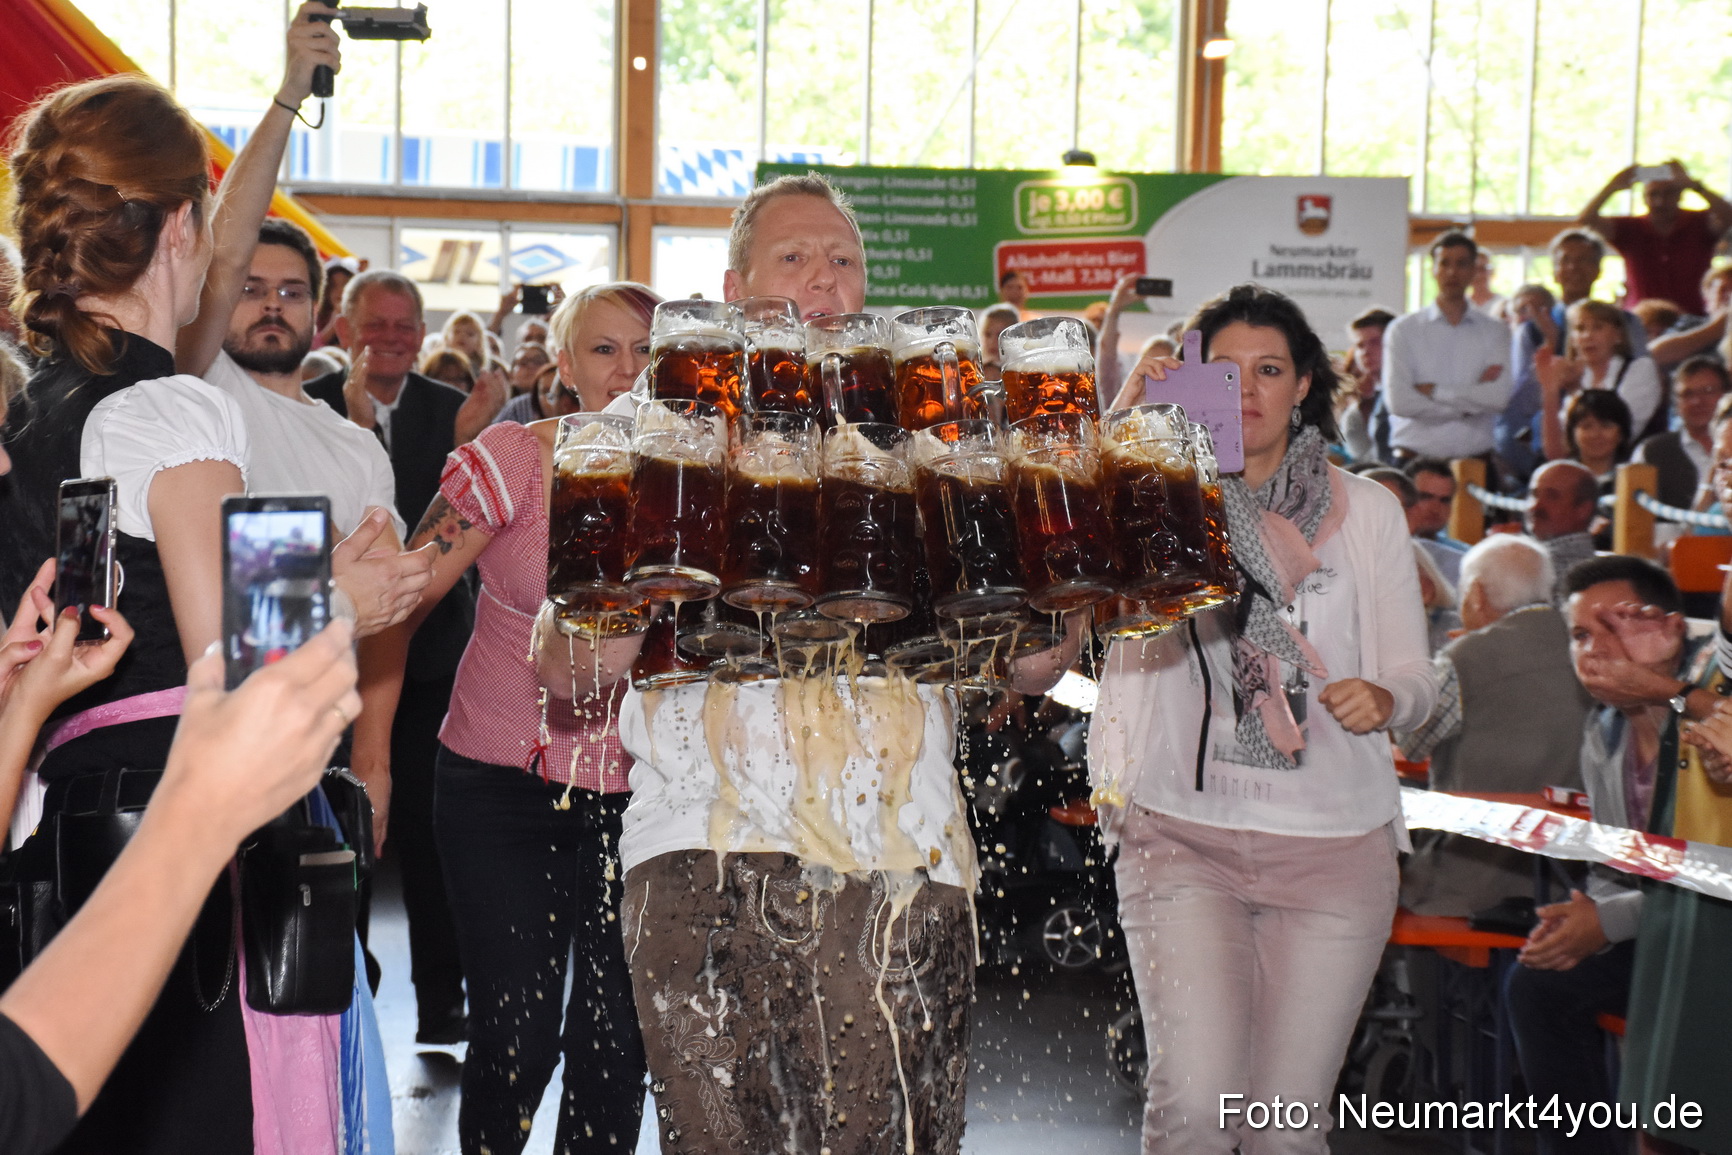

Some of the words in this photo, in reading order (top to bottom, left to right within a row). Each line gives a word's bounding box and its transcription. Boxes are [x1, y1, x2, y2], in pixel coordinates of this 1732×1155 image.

[1054, 188, 1105, 213] 3,00
[1108, 187, 1124, 209] €
[1006, 252, 1104, 268] Alkoholfreies
[1107, 250, 1137, 265] Bier
[1269, 244, 1359, 256] Neumarkter
[1252, 259, 1373, 279] Lammsbräu
[1210, 774, 1273, 800] MOMENT
